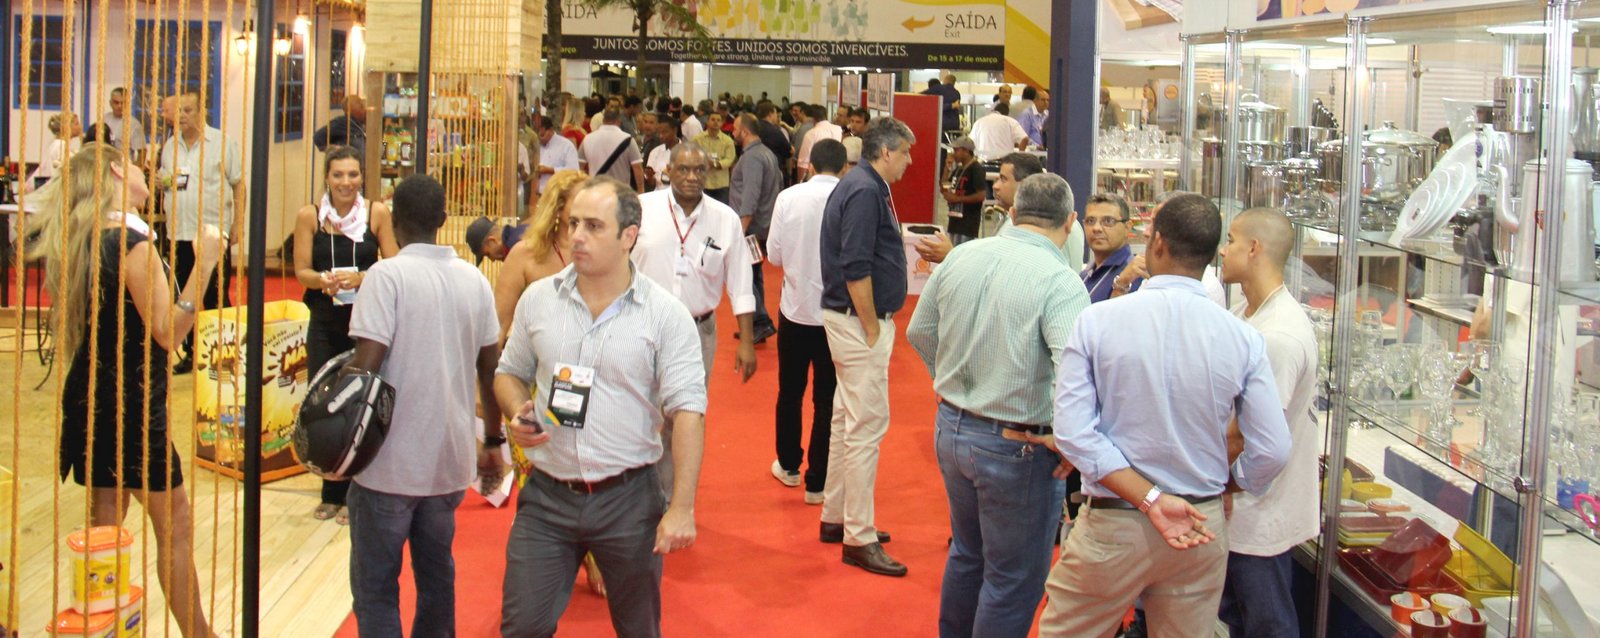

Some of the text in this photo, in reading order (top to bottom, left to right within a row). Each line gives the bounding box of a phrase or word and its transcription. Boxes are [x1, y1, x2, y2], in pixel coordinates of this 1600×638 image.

[945, 10, 997, 30] SAÍDA
[944, 29, 960, 38] Exit
[592, 38, 909, 57] JUNTOS OMOS FOTES. UNIDOS SOMOS INVENCÍVEIS.
[670, 52, 700, 61] Together
[751, 53, 774, 61] United
[927, 54, 938, 62] De
[940, 54, 948, 62] 15
[964, 55, 974, 63] de
[975, 56, 998, 64] março
